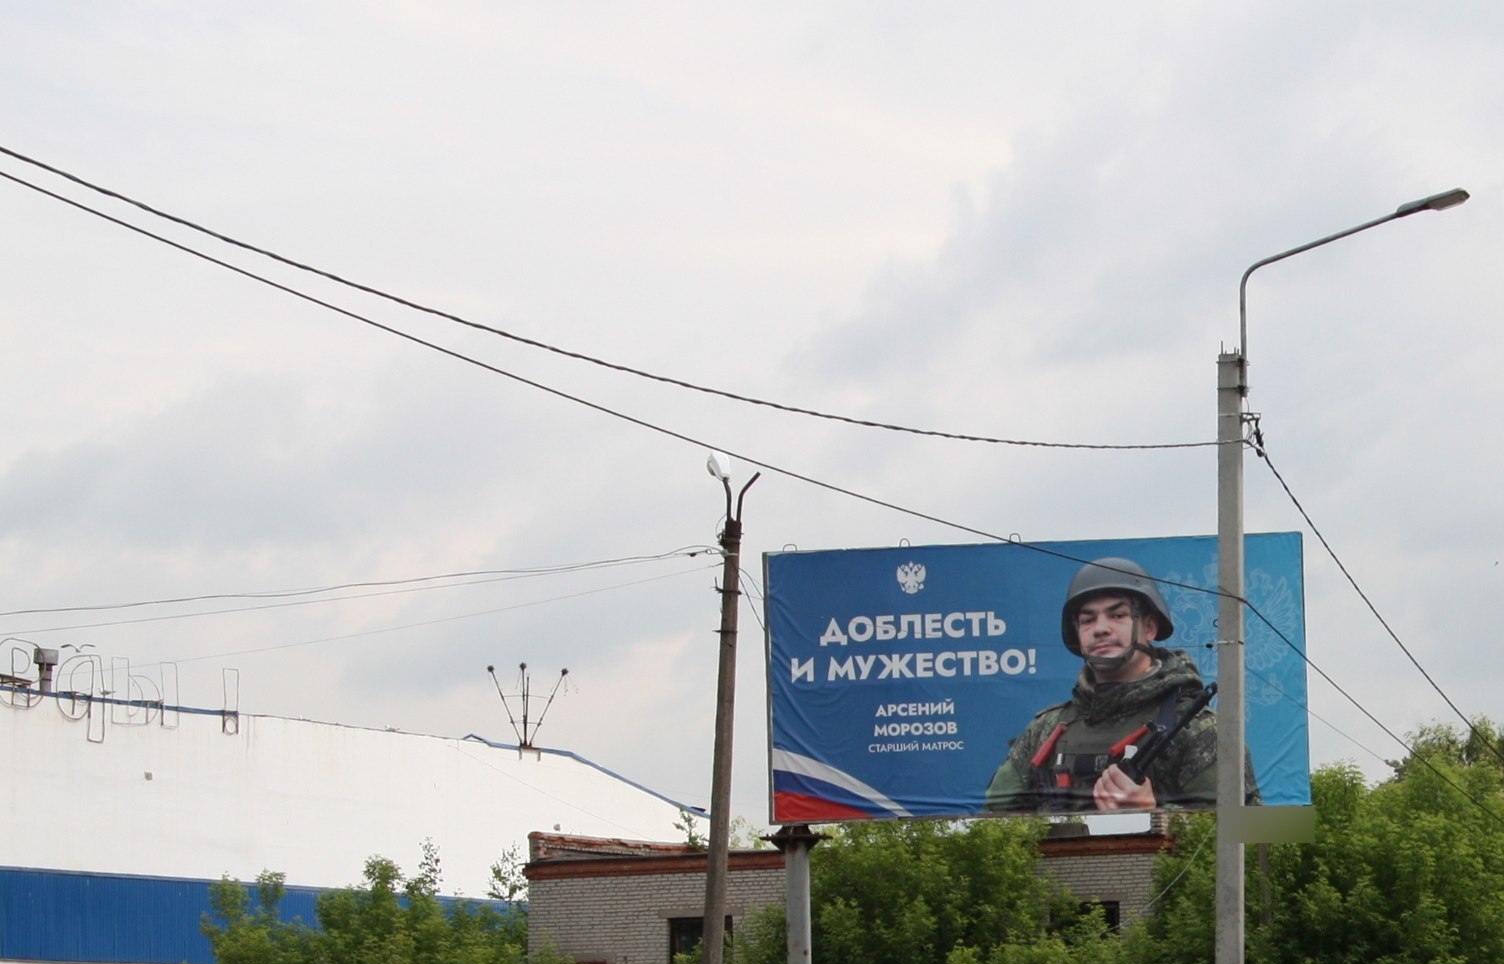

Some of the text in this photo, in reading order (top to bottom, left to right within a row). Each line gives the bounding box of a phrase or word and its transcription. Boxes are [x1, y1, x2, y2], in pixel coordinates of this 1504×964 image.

[820, 611, 1007, 646] ДОБЛЕСТЬ
[791, 648, 1037, 684] И МУЖЕСТВО!
[875, 698, 955, 717] АРСЕНИЙ
[873, 721, 958, 737] МОРОЗОВ
[868, 740, 964, 753] СТАРШИЙ МАТРОС
